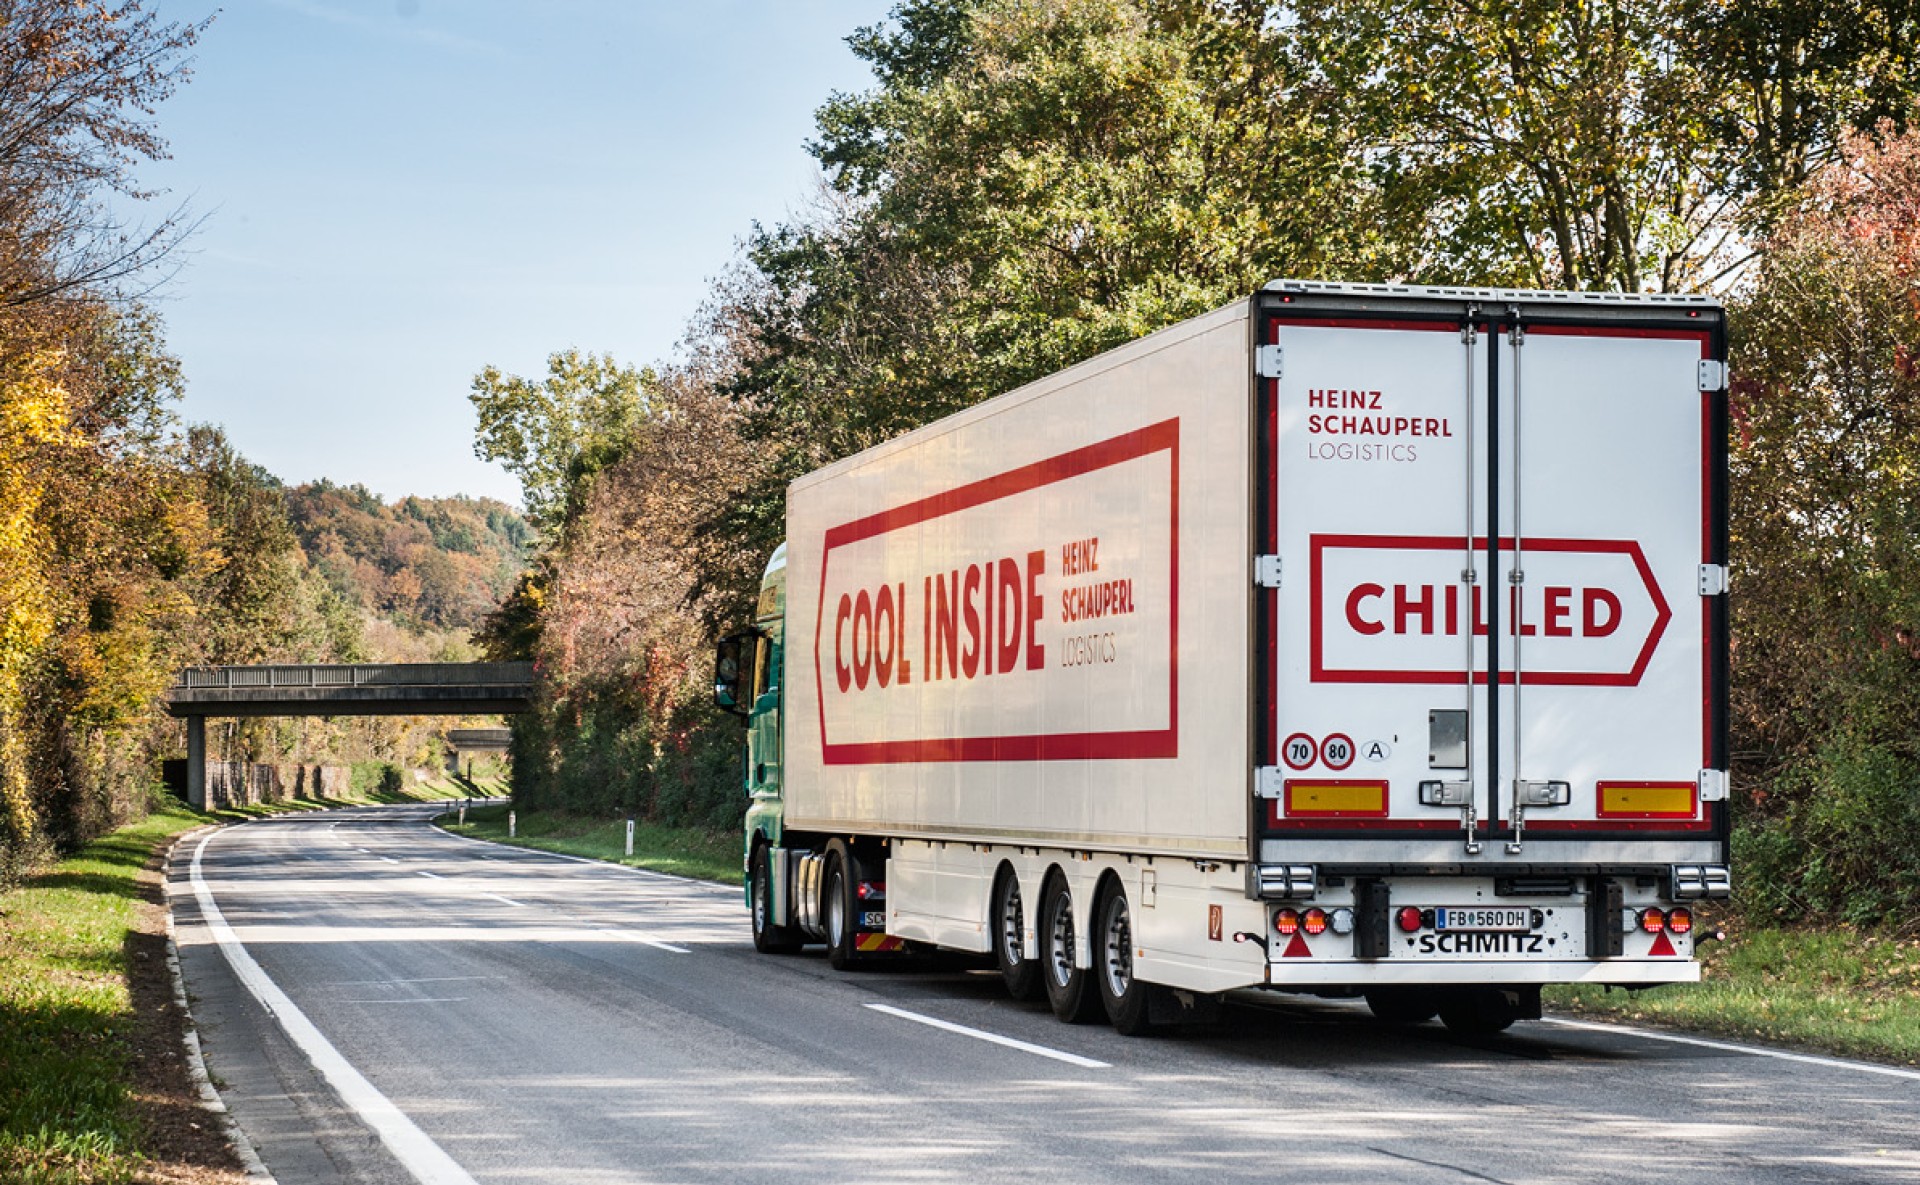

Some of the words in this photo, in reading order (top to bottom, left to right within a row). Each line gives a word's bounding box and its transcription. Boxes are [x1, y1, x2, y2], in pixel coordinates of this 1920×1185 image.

[1309, 389, 1382, 410] HEINZ
[1308, 414, 1452, 437] SCHAUPERL
[1309, 442, 1417, 462] LOGISTICS
[1062, 537, 1099, 577] HEINZ
[1062, 578, 1134, 622] SCHAUPERL
[1345, 582, 1623, 638] CHILLED
[835, 582, 911, 693] COOL
[923, 550, 1046, 682] INSIDE
[1062, 632, 1116, 667] LOGISTICS
[1292, 744, 1309, 759] 70
[1328, 744, 1346, 759] 80
[1368, 742, 1384, 758] A
[1449, 911, 1467, 926] FB
[1477, 911, 1504, 926] 560
[1507, 911, 1525, 926] DH
[1419, 934, 1544, 953] SCHMITZ
